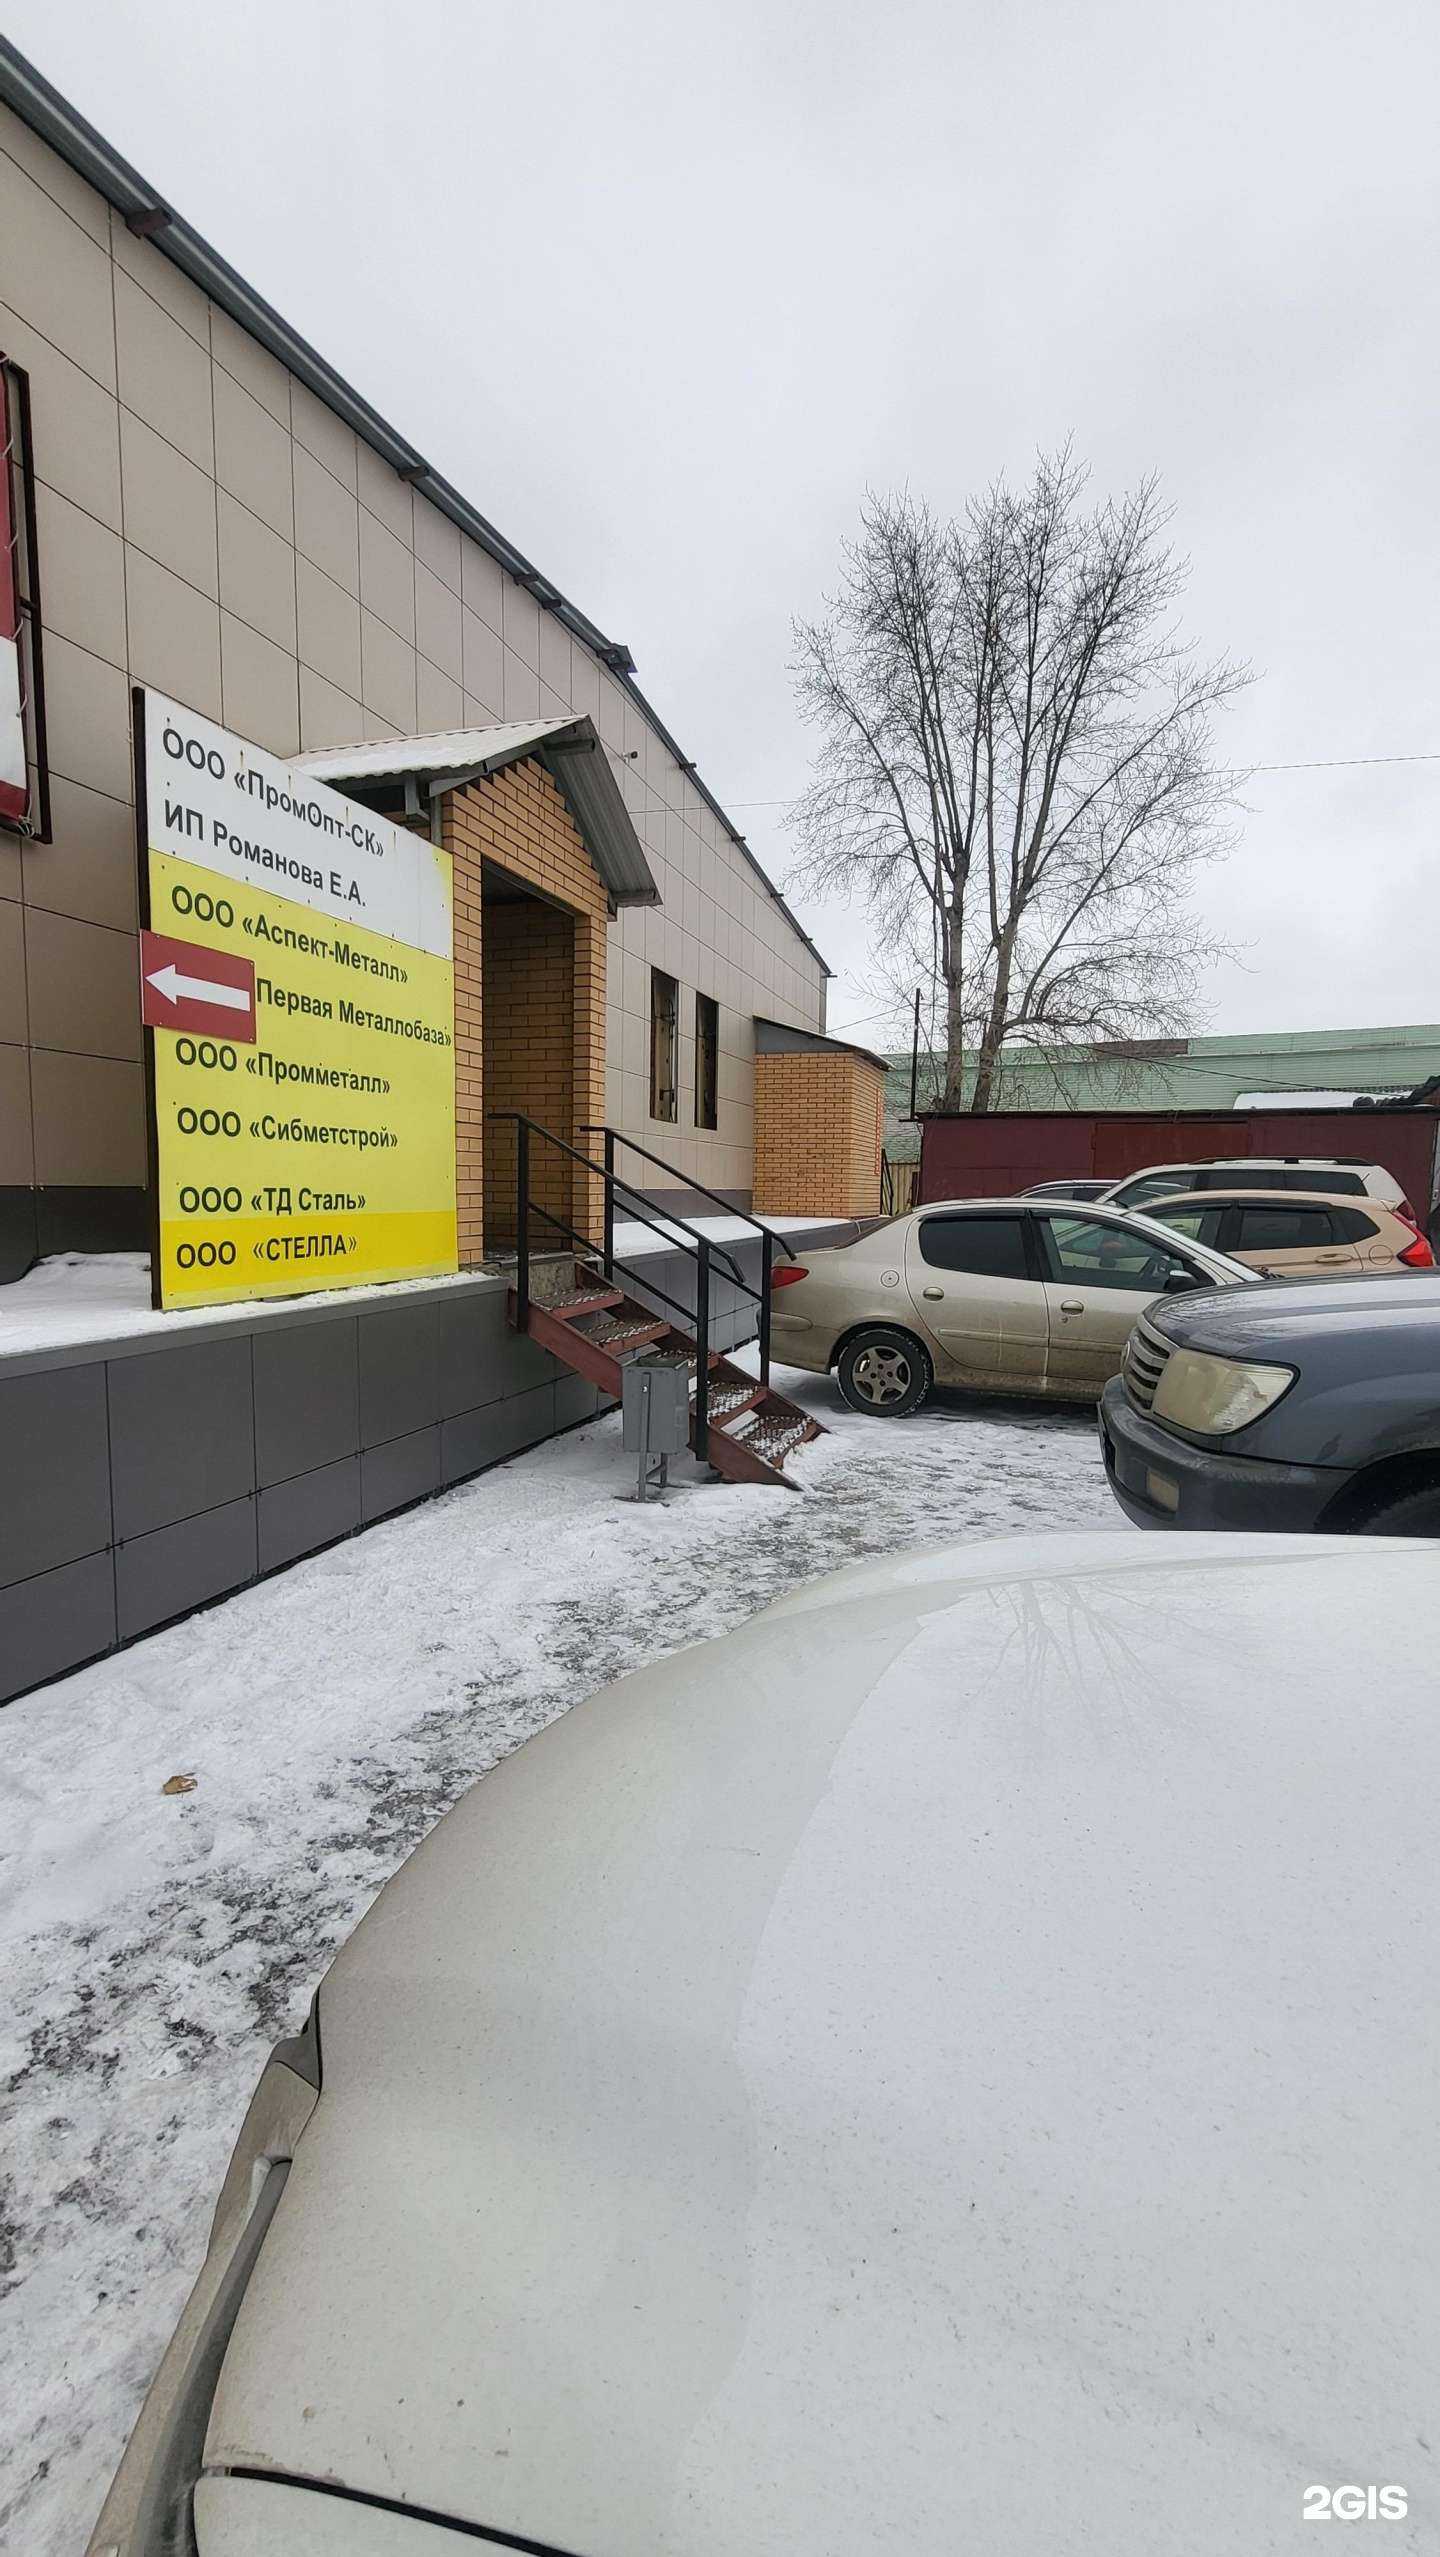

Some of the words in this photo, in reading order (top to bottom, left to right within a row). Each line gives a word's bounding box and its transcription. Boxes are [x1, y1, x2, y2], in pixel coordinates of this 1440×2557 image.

[162, 727, 226, 780] ООО
[234, 768, 385, 857] «ПромОпт-СК»
[164, 799, 204, 841] ИП
[213, 820, 324, 892] Романова
[329, 871, 367, 906] Е.А.
[171, 885, 235, 928] ООО
[242, 913, 409, 985] «Аспект-Металл»
[256, 978, 334, 1020] Первая
[338, 1000, 452, 1047] Металлобаза»
[175, 1037, 238, 1072] ООО
[245, 1051, 391, 1094] «Промметалл»
[177, 1107, 242, 1138] ООО
[249, 1114, 399, 1152] «Сибметстрой»
[179, 1186, 243, 1213] ООО
[251, 1187, 293, 1216] «ТД
[298, 1187, 367, 1212] Сталь»
[176, 1240, 237, 1269] ООО
[252, 1234, 358, 1262] «СТЕЛЛА»
